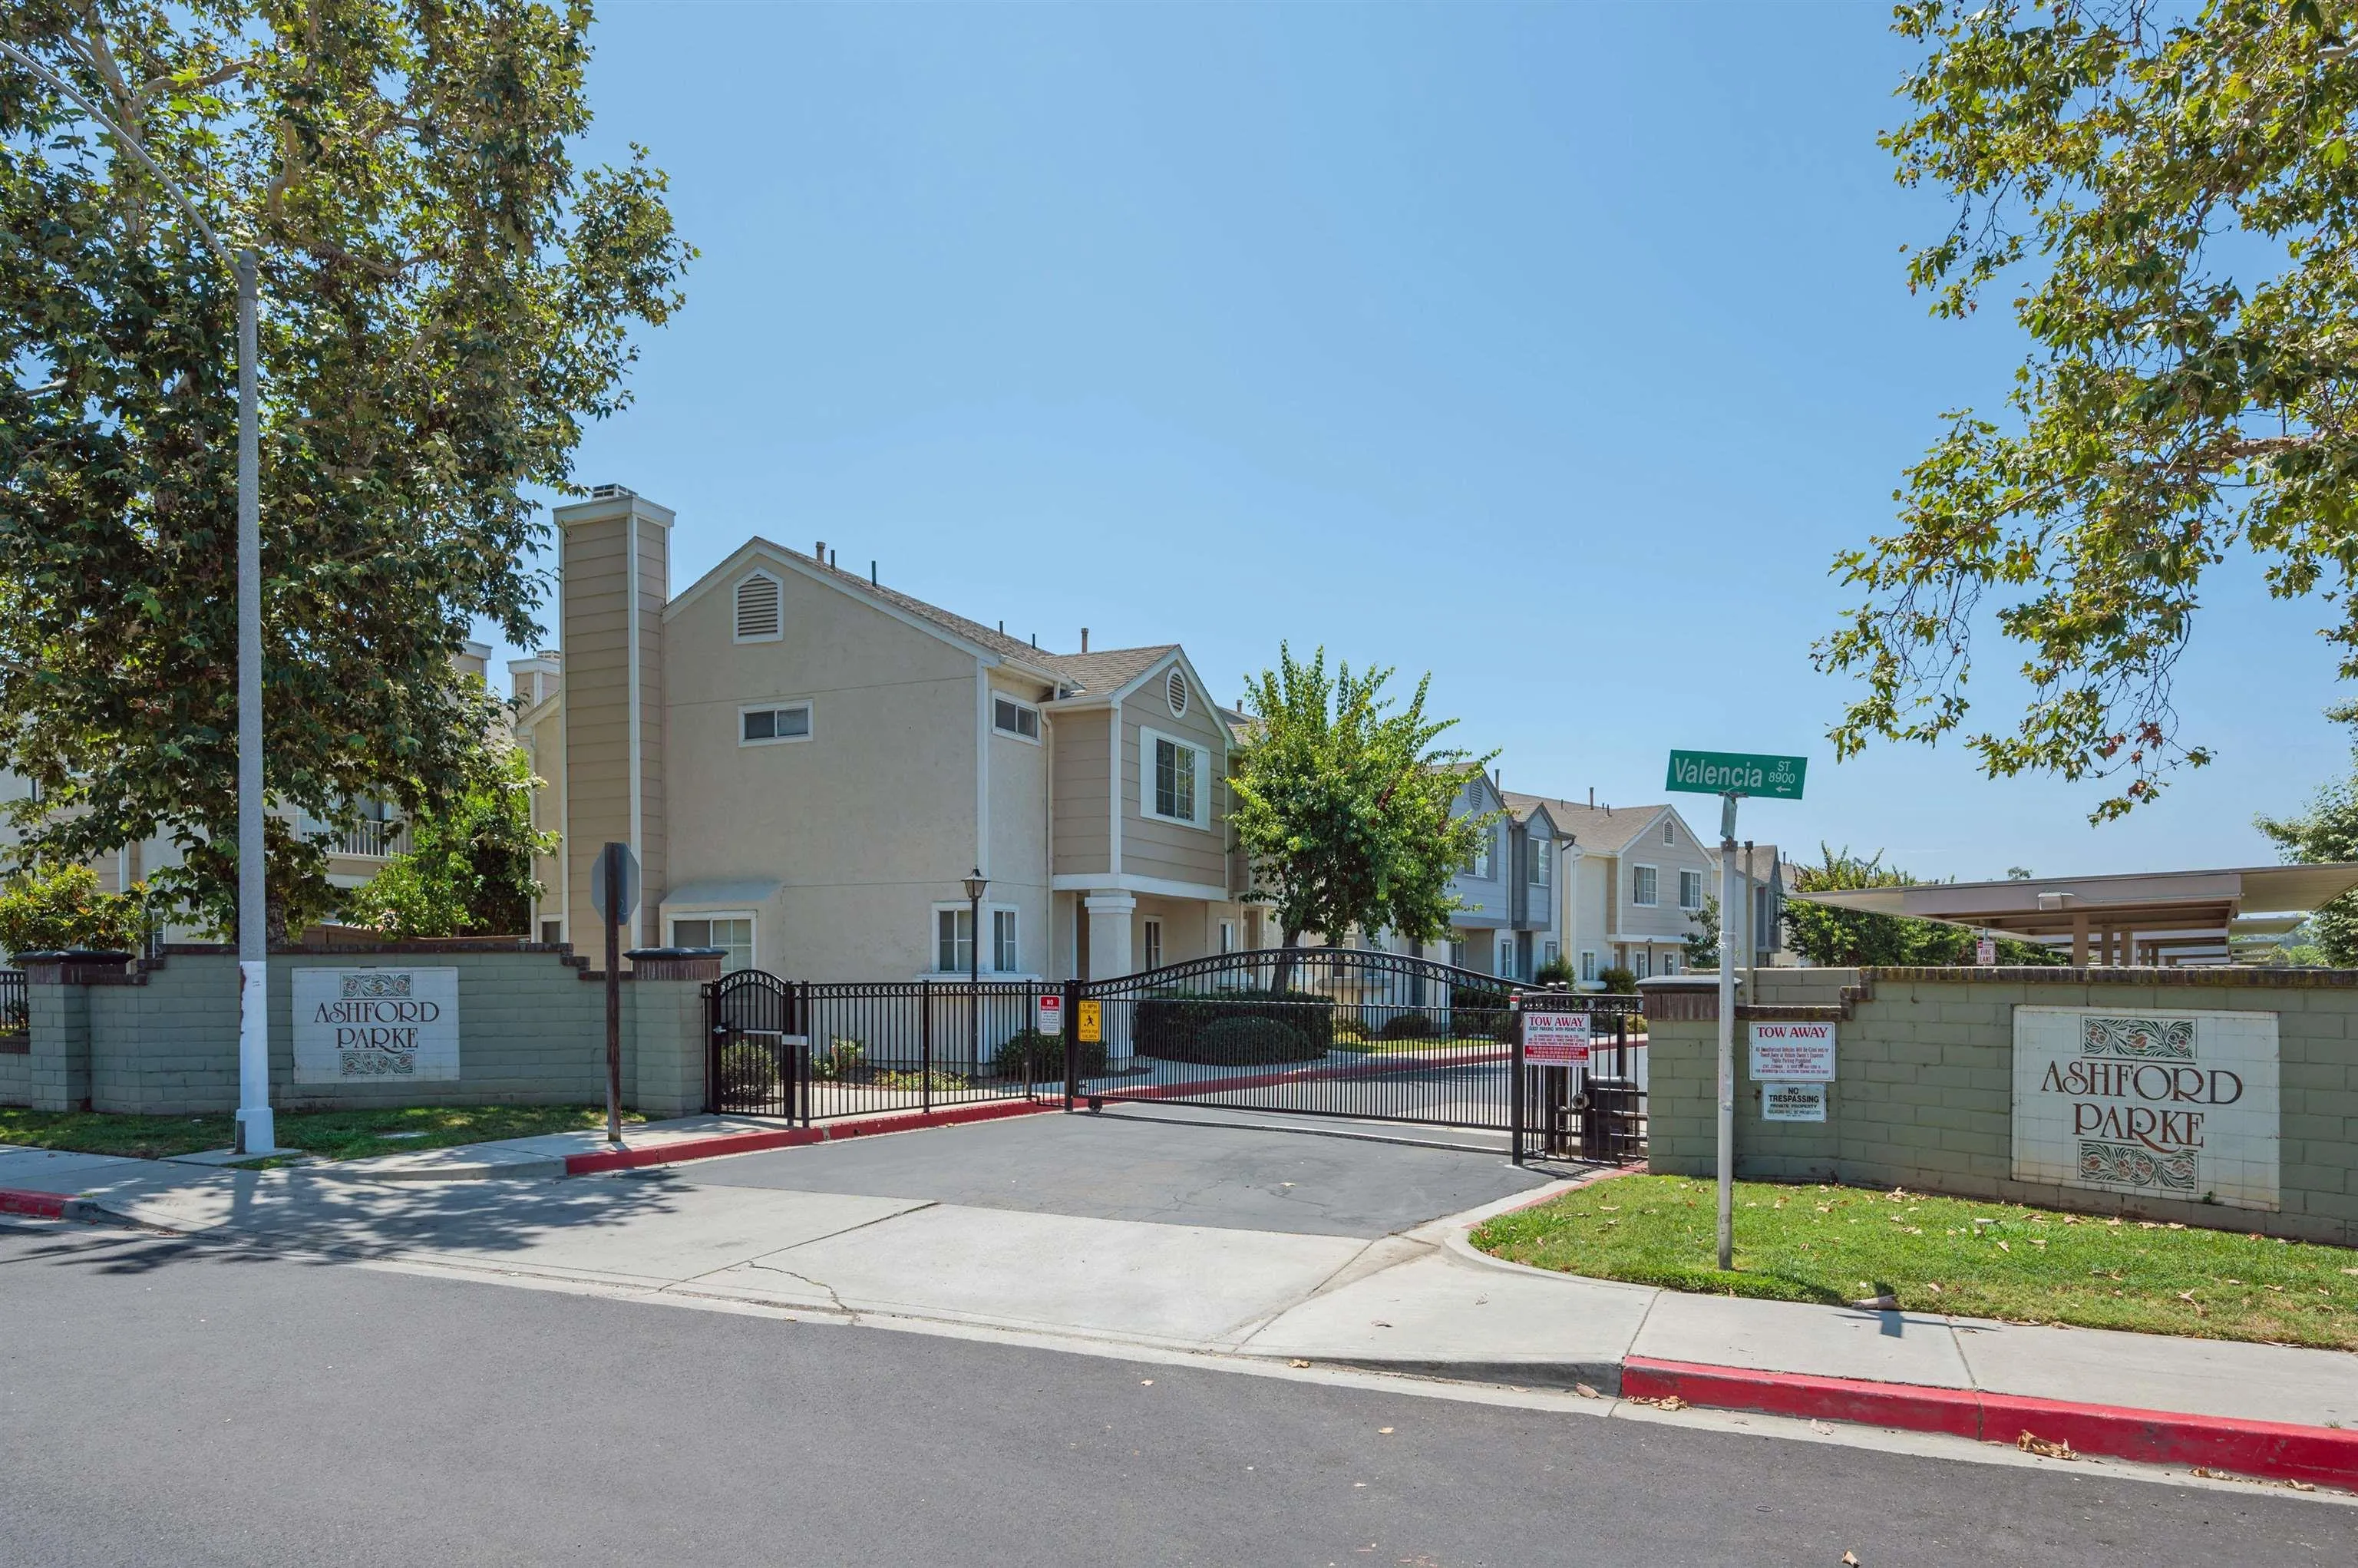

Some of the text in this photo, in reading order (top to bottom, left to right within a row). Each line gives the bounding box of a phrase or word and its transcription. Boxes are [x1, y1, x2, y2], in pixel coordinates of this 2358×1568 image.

[1675, 758, 1762, 787] Valencia
[1777, 761, 1792, 772] ST
[1768, 772, 1795, 784] 8900
[314, 1001, 440, 1023] ASHFORD
[1529, 1016, 1584, 1027] TOW AWAY
[335, 1027, 418, 1054] PARKE
[1756, 1027, 1828, 1038] TOW AWAY
[2040, 1061, 2243, 1104] ASHFORD
[2072, 1103, 2204, 1154] PARKE
